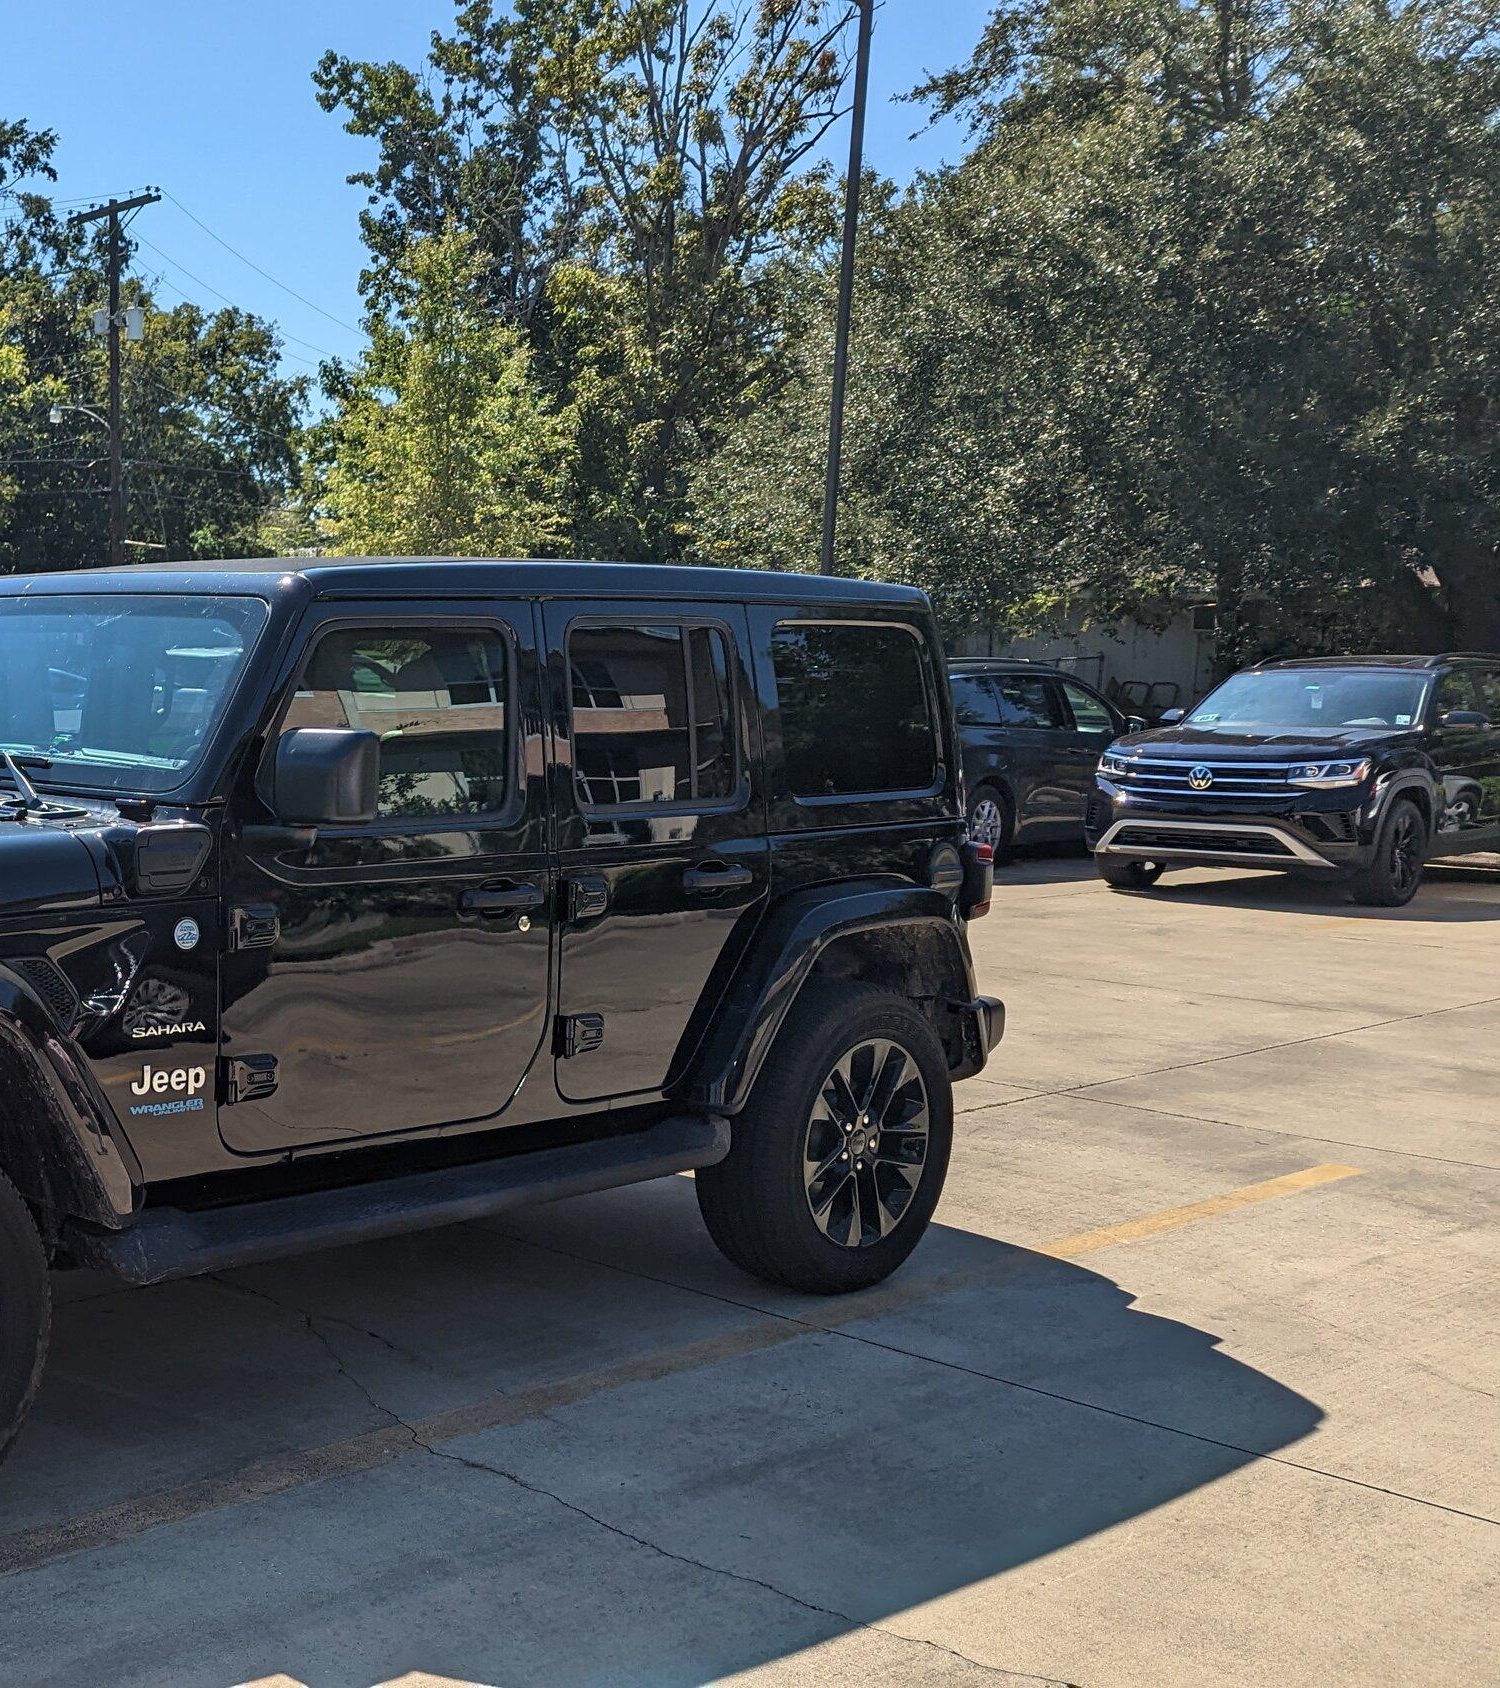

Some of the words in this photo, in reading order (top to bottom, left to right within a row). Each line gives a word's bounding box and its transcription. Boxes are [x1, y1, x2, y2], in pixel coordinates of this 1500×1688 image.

[132, 1021, 206, 1038] SAHARA
[131, 1065, 206, 1095] Jeep
[130, 1098, 203, 1115] WRANGLER
